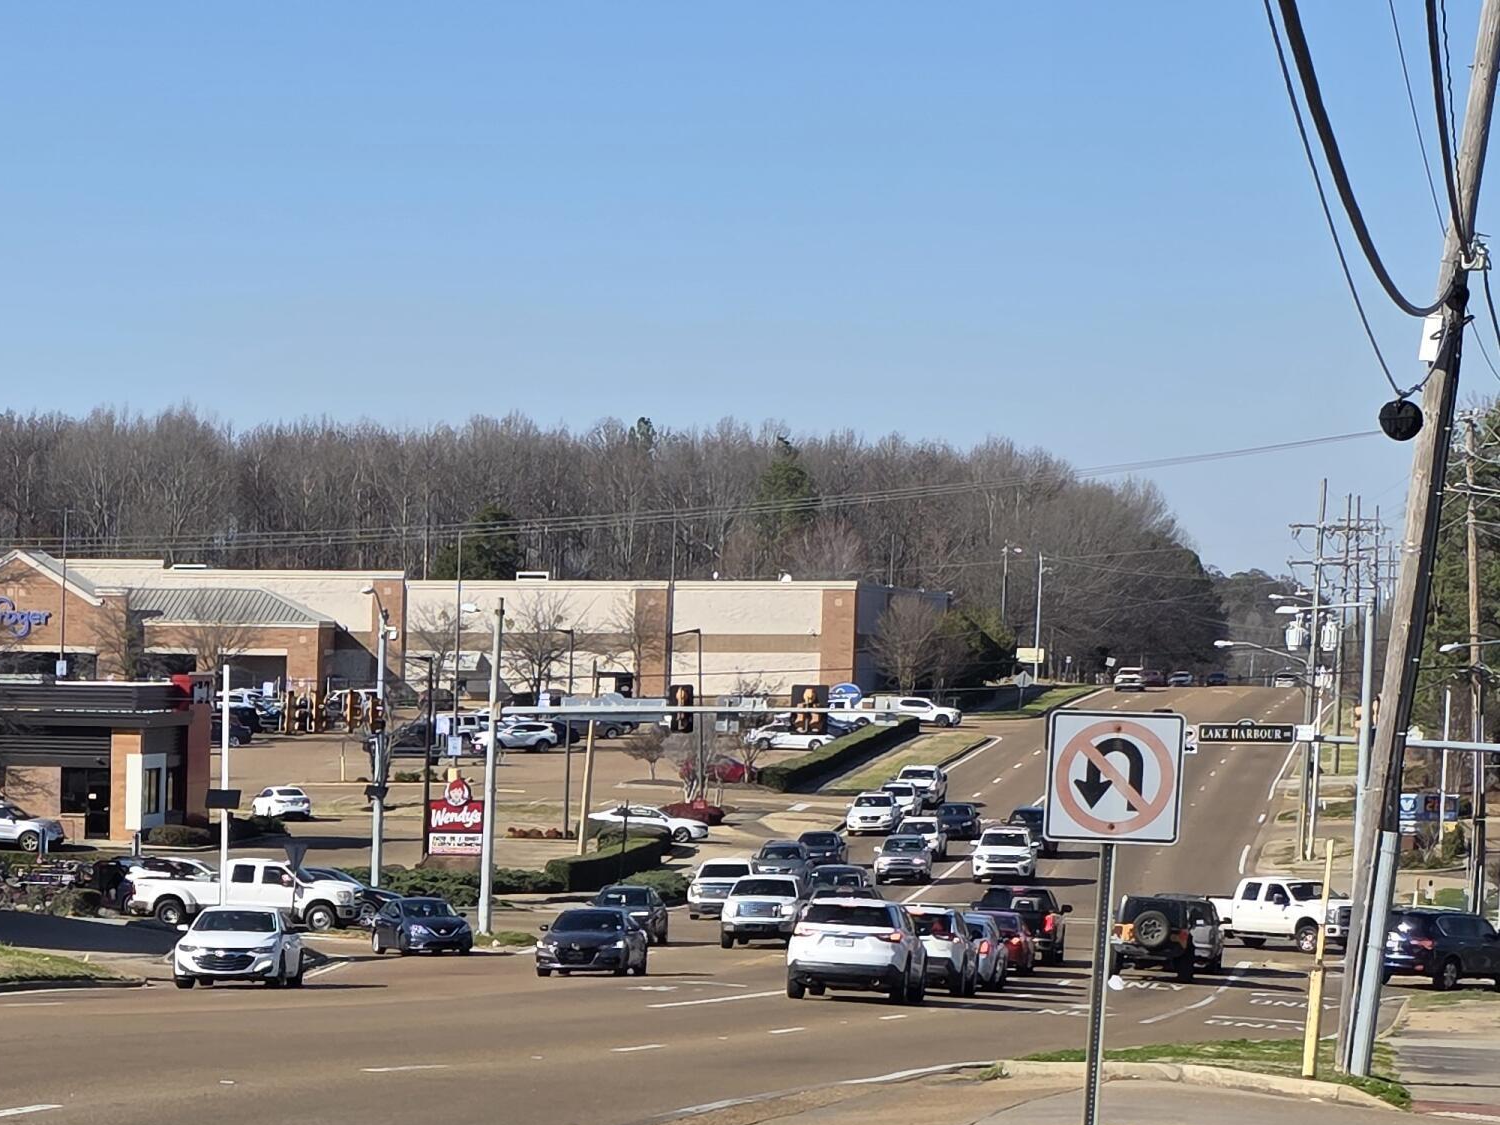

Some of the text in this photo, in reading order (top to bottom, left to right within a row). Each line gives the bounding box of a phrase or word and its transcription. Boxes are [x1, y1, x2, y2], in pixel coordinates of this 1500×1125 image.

[1201, 728, 1229, 739] LAKE
[1231, 728, 1282, 740] HARBOUR
[1122, 980, 1187, 992] NLY
